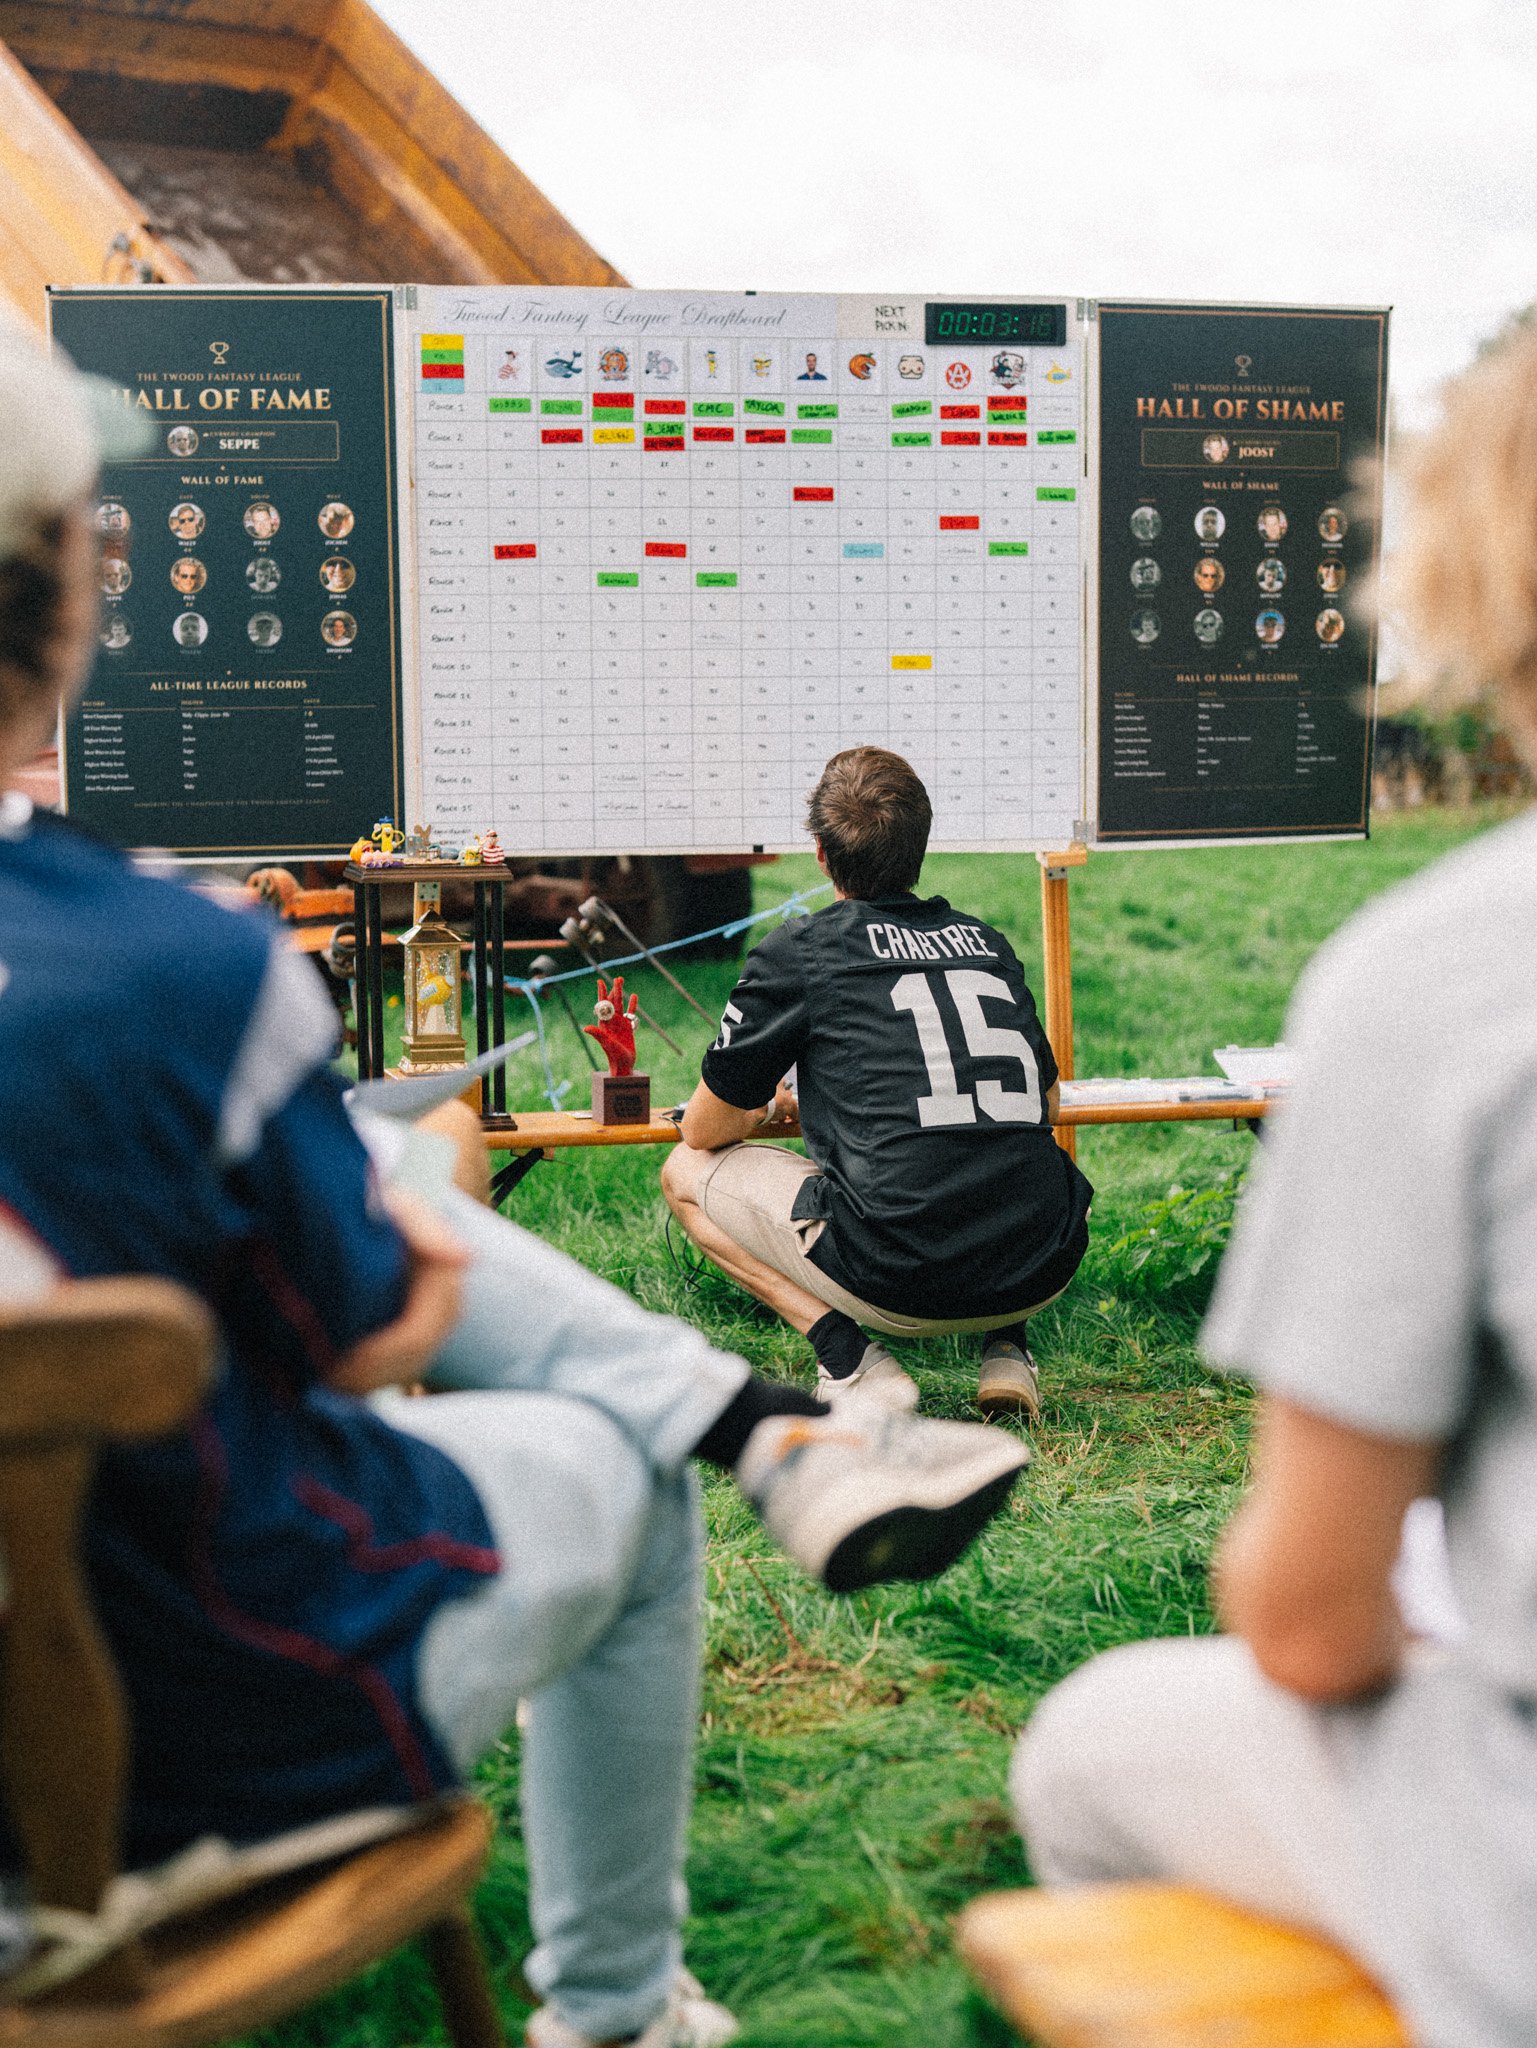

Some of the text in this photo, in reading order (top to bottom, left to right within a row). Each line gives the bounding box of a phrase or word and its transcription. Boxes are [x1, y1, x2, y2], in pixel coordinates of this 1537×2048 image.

[444, 300, 787, 332] Twood Fantasy League Draftboard
[875, 305, 905, 317] NEXT
[137, 373, 302, 382] THE TWOOD FANTASY LEAGUE
[1172, 383, 1312, 395] THE TWOOD FANTASY LEAGUE
[199, 388, 240, 410] OF
[250, 389, 332, 410] FAME
[698, 404, 723, 413] CMC
[745, 400, 780, 414] TAYLOR
[1137, 397, 1345, 422] HALL OF SHAME
[219, 439, 260, 450] SEPPE
[1238, 447, 1275, 459] JOOST
[181, 476, 264, 485] WALL OF FAME
[1203, 481, 1280, 491] WALL OF SHAME
[1176, 674, 1201, 683] HALL
[1219, 673, 1251, 682] SHAME
[1255, 673, 1298, 682] RECORDS
[150, 680, 308, 690] ALL-TIME LEAGUE RECORDS
[866, 922, 999, 961] CRABTREE
[890, 969, 1043, 1128] 15
